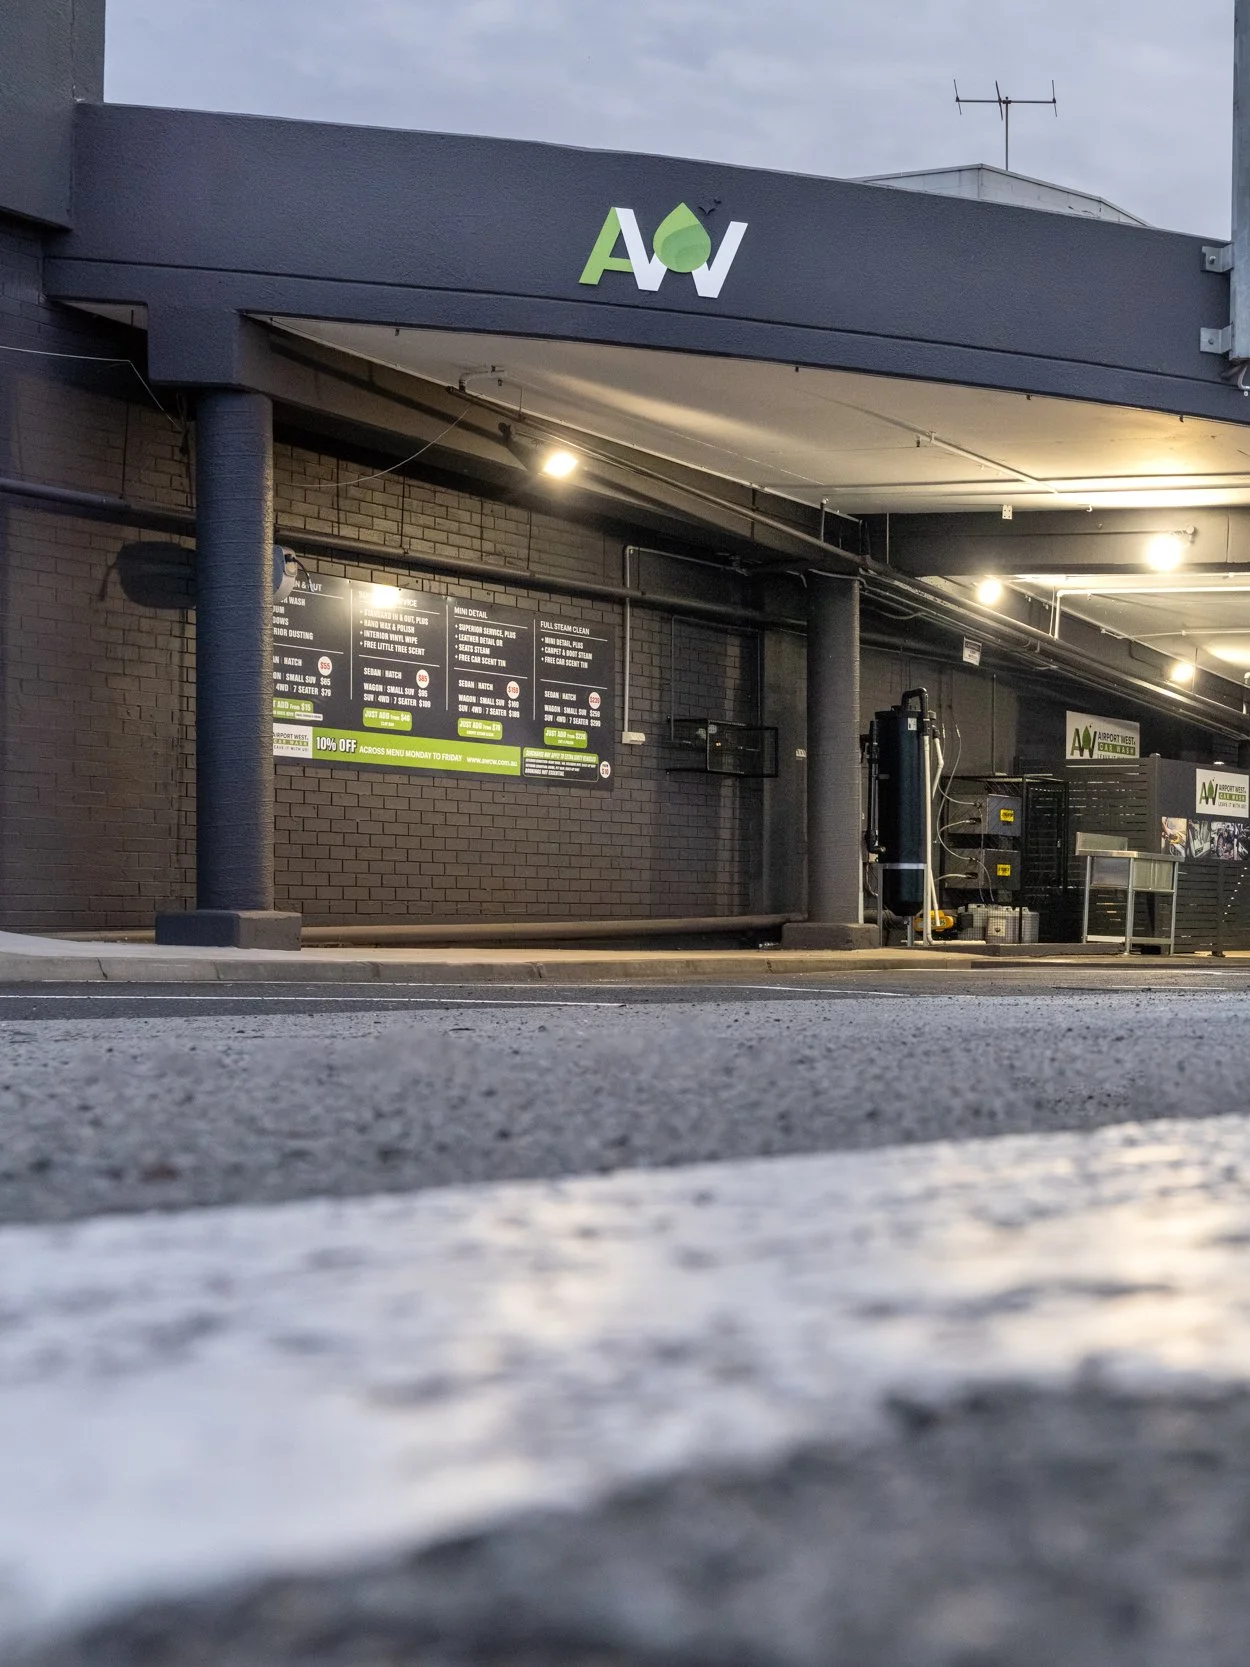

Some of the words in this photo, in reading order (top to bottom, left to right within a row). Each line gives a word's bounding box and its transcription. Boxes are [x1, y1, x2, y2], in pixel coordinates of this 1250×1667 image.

[289, 596, 306, 607] WASH
[454, 606, 468, 616] MINI
[468, 609, 488, 619] DETAIL
[396, 625, 415, 634] POLISH
[458, 623, 483, 634] SUPERIOR
[504, 630, 517, 640] PLUS
[540, 620, 553, 630] FULL
[553, 623, 572, 632] STEAM
[572, 625, 590, 635] CLEAN
[288, 629, 314, 640] DUSTING
[363, 629, 389, 641] INTERIOR
[389, 632, 404, 643] VINYL
[404, 635, 418, 645] WIPE
[480, 636, 496, 646] DETAIL
[544, 636, 556, 645] MINI
[363, 640, 377, 650] FREE
[377, 642, 394, 652] LITTLE
[394, 644, 408, 654] TREE
[408, 645, 425, 656] SCENT
[458, 643, 474, 653] SEATS
[474, 646, 490, 655] STEAM
[544, 646, 562, 656] CARPET
[458, 653, 471, 663] FREE
[471, 656, 481, 664] CAR
[481, 657, 497, 666] SCENT
[497, 659, 507, 668] TIN
[544, 656, 556, 664] FREE
[556, 657, 565, 666] CAR
[565, 659, 580, 668] SCENT
[286, 673, 304, 683] SMALL
[363, 667, 382, 677] SEDAN
[384, 669, 402, 679] HATCH
[363, 682, 383, 692] WAGON
[386, 685, 404, 695] SMALL
[458, 679, 475, 689] SEDAN
[298, 686, 319, 696] SEATER
[544, 690, 560, 699] SEDAN
[397, 697, 417, 707] SEATER
[458, 694, 477, 703] WAGON
[479, 696, 495, 706] SMALL
[489, 708, 507, 717] SEATER
[1097, 731, 1120, 743] AIRPORT
[316, 736, 337, 751] 10%
[339, 738, 357, 753] OFF
[359, 745, 385, 756] ACROSS
[386, 748, 405, 757] MENU
[405, 750, 432, 760] MONDAY
[433, 752, 441, 761] TO
[442, 753, 463, 762] FRIDAY
[1099, 743, 1113, 752] CAR
